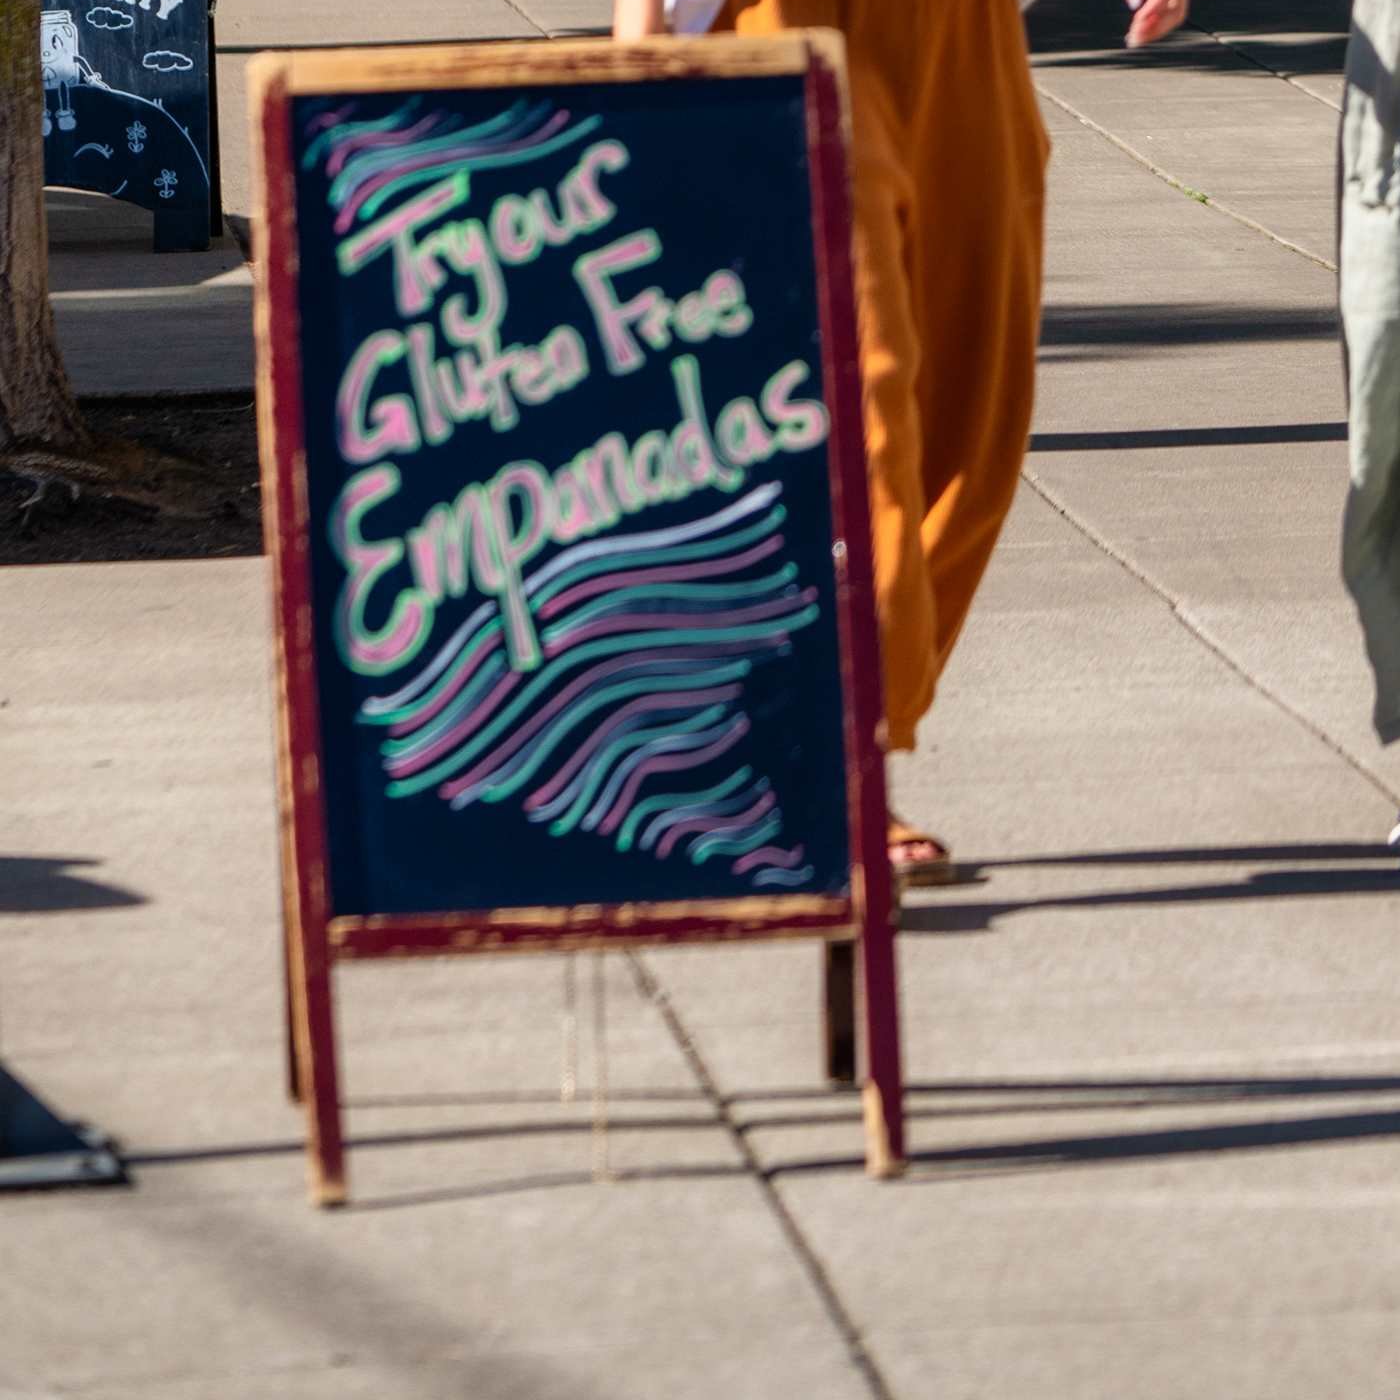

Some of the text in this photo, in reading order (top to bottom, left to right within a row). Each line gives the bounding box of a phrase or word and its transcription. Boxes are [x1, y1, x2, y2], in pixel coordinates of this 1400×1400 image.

[336, 138, 630, 344] Try our
[337, 229, 754, 464] Gluten Free
[328, 354, 830, 676] Empanadas
